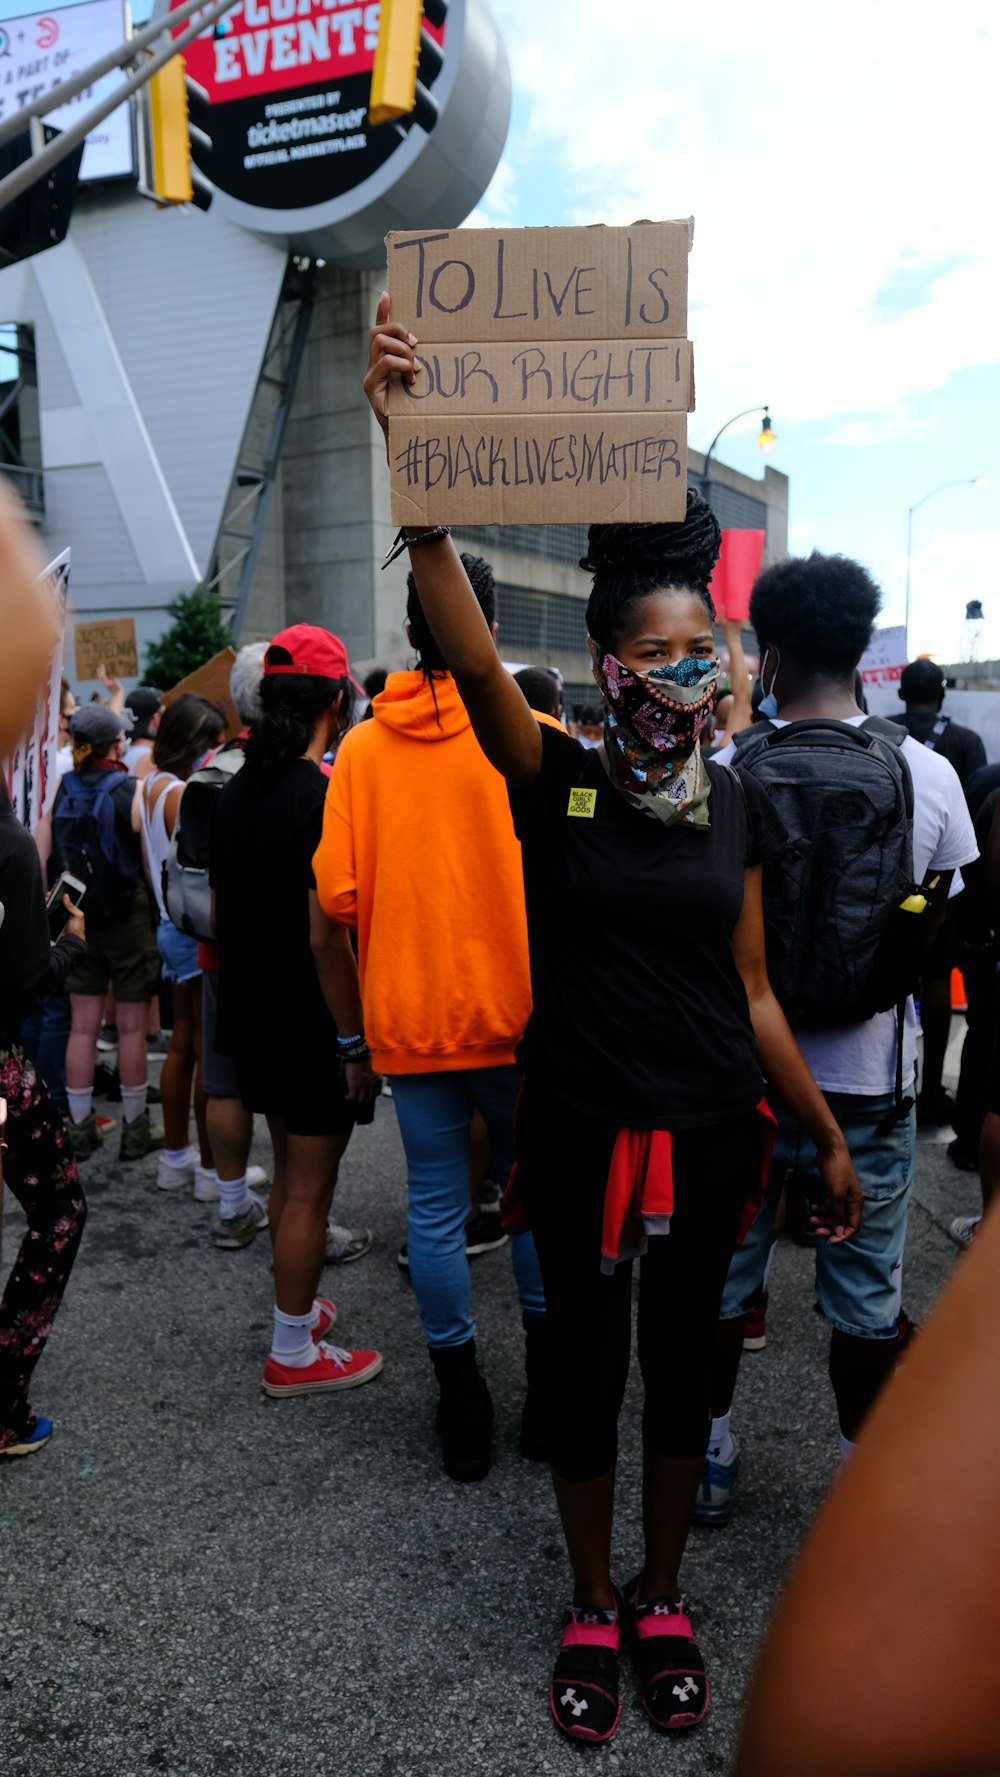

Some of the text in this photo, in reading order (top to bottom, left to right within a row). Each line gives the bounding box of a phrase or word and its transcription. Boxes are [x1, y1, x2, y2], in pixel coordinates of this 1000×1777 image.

[17, 57, 49, 80] PART
[53, 49, 70, 67] OF
[214, 5, 381, 83] EVENTS
[247, 106, 368, 149] ticketmaster
[394, 233, 670, 327] TO LIVE IS
[402, 346, 681, 407] OUR RIGHT!
